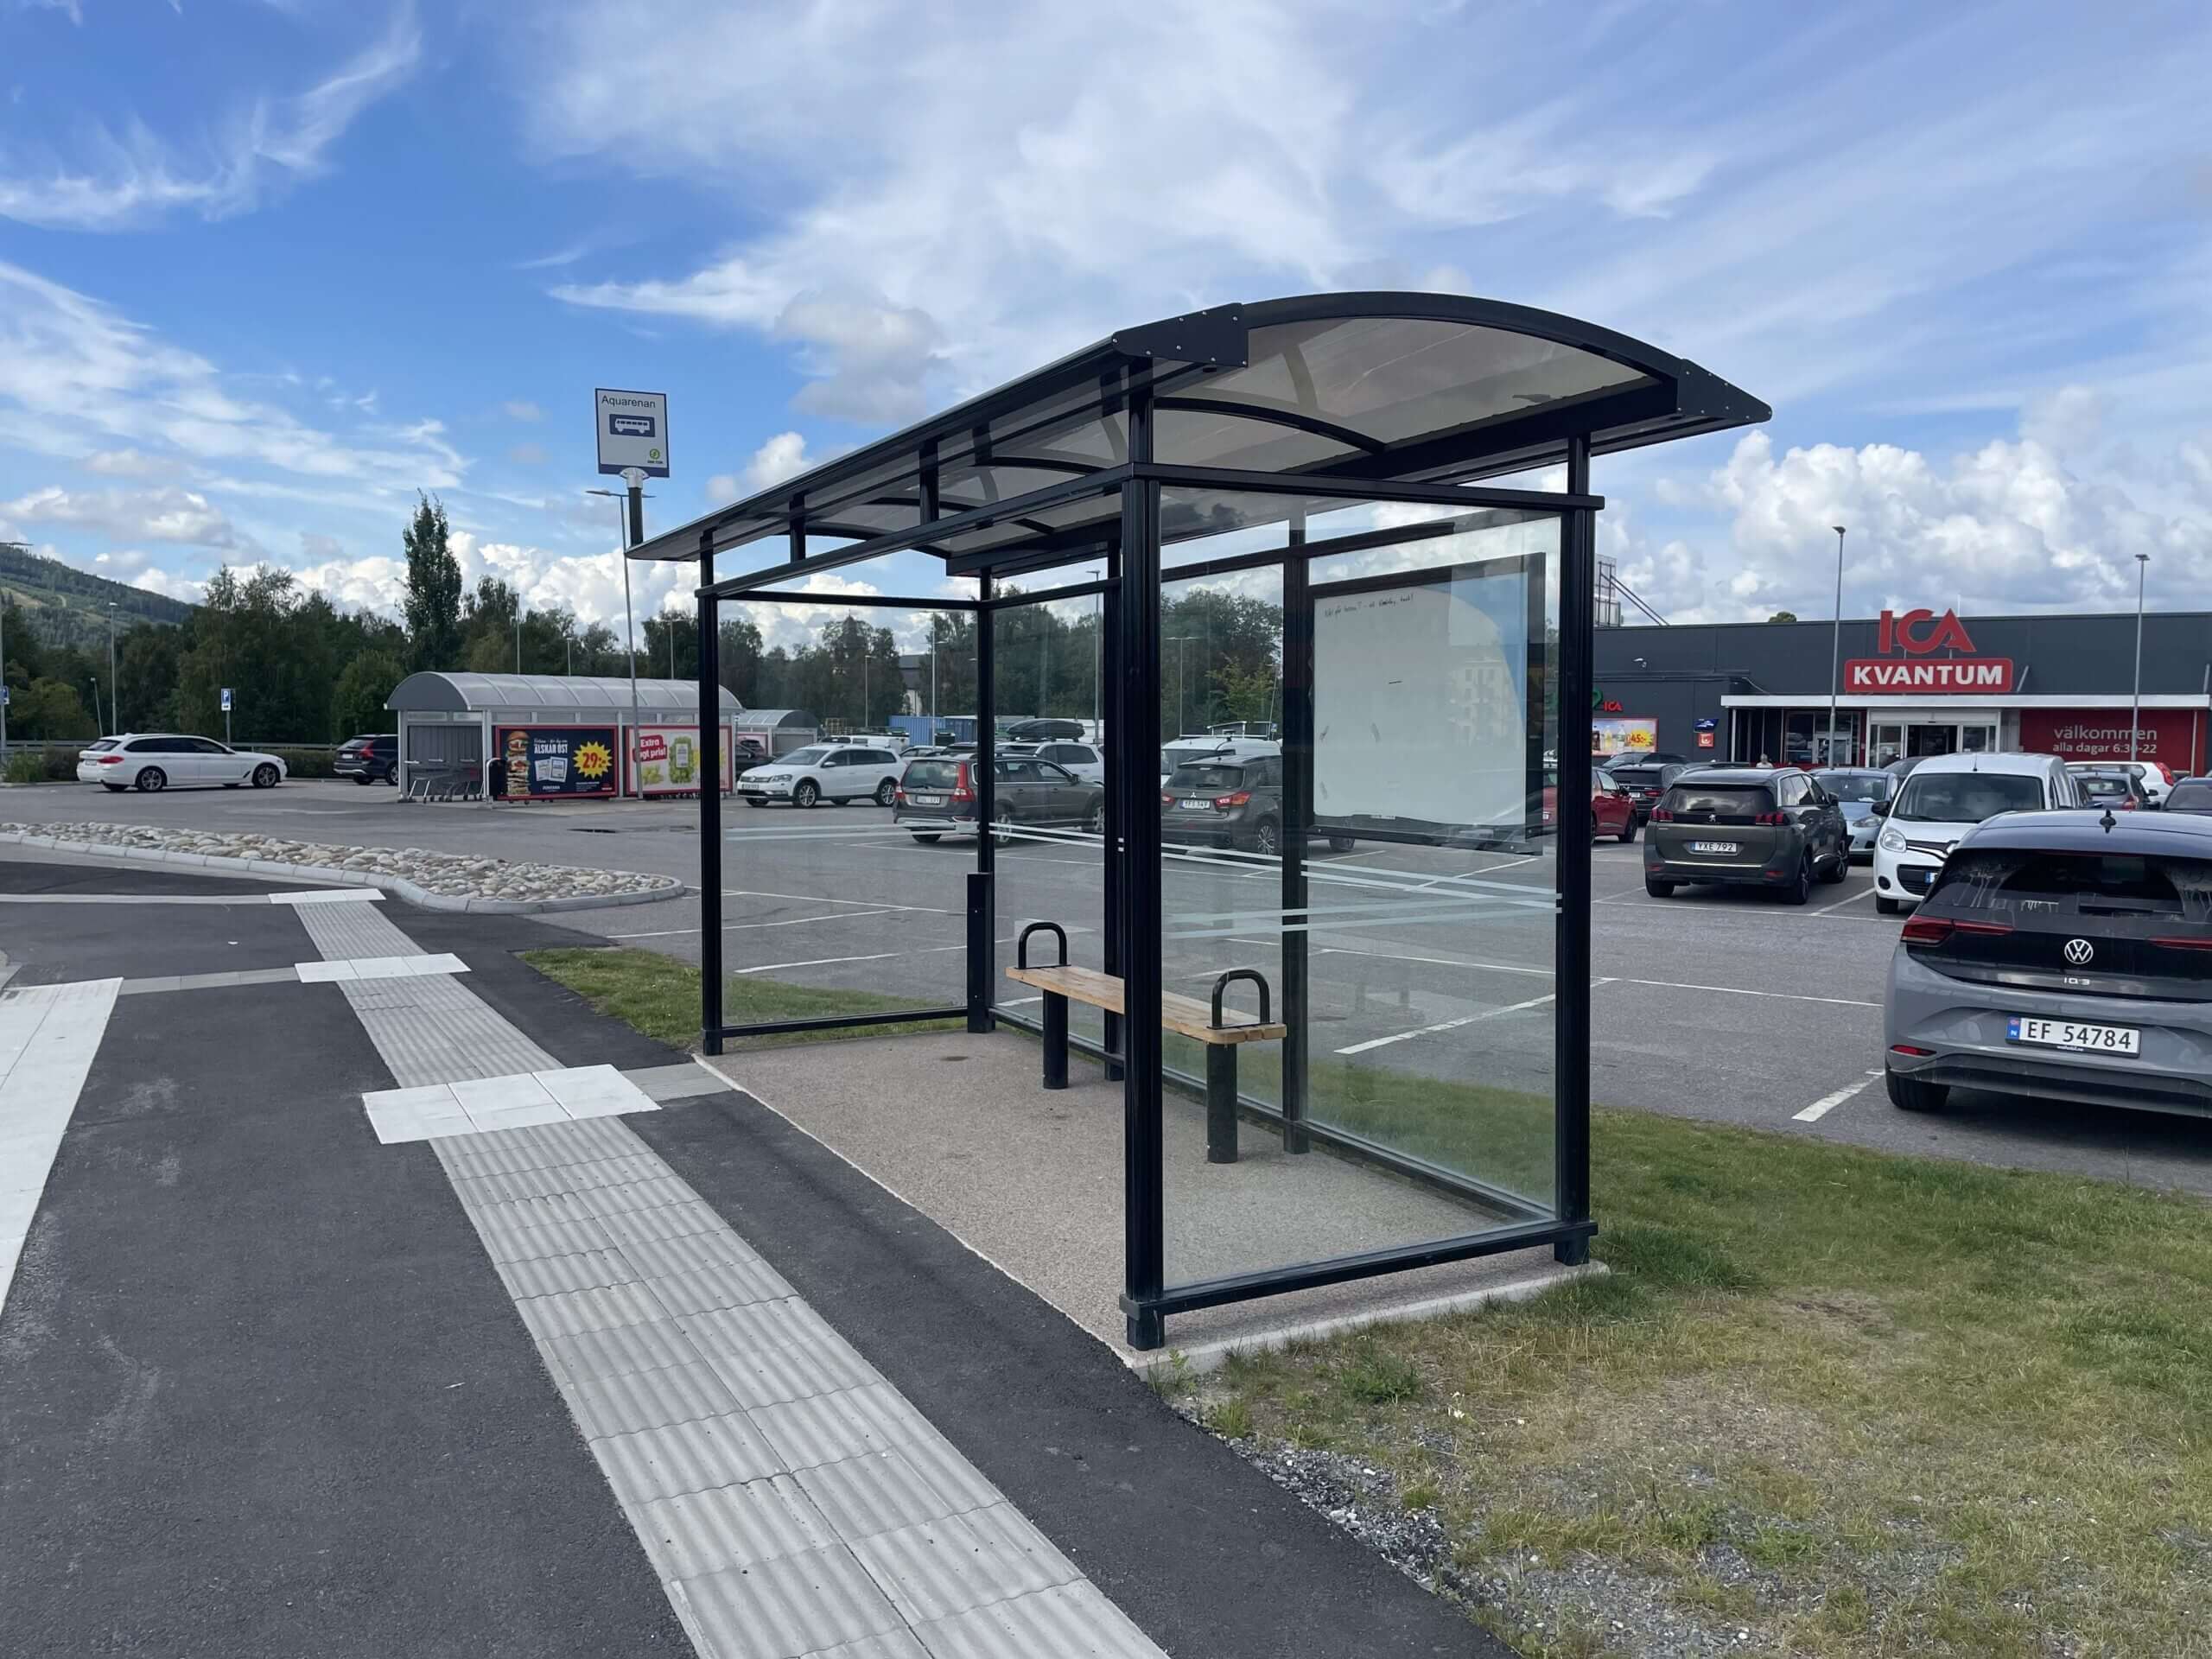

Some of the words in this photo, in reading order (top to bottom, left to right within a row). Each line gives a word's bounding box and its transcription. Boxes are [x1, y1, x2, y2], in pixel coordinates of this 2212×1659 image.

[601, 394, 656, 409] Aquarenan
[1878, 607, 1977, 654] ICA
[1853, 664, 2003, 685] KVANTUM
[223, 690, 229, 702] P
[1604, 700, 1623, 712] ICA
[2053, 724, 2158, 741] välkommen
[640, 738, 660, 747] Extra
[2052, 742, 2073, 753] alla
[2075, 742, 2109, 755] dagar
[582, 752, 607, 769] 29:-
[1716, 842, 1733, 851] 792
[2027, 1021, 2051, 1039] EF
[2063, 1026, 2132, 1050] 54784
